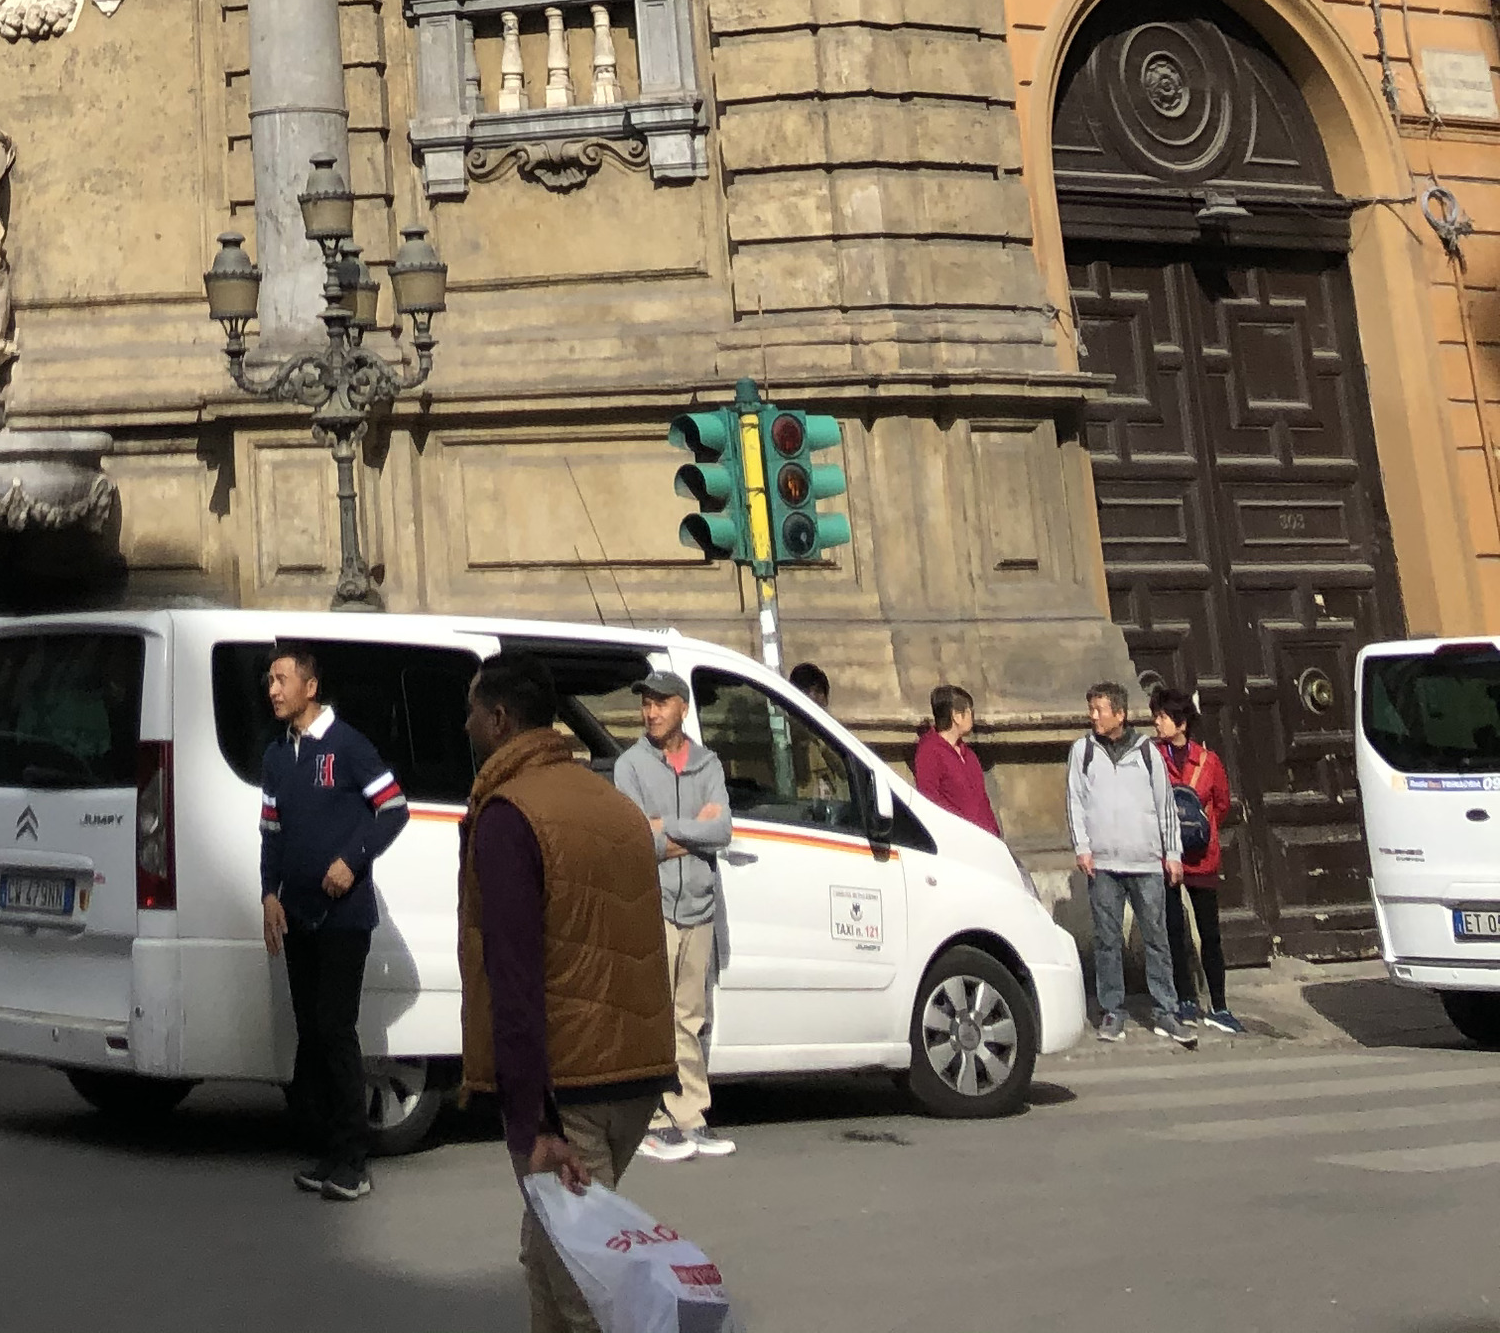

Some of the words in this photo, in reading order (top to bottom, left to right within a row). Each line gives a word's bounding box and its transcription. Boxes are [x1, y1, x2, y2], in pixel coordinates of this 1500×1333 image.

[835, 922, 854, 936] TAXI
[865, 925, 879, 939] 121
[1464, 914, 1482, 933] ET
